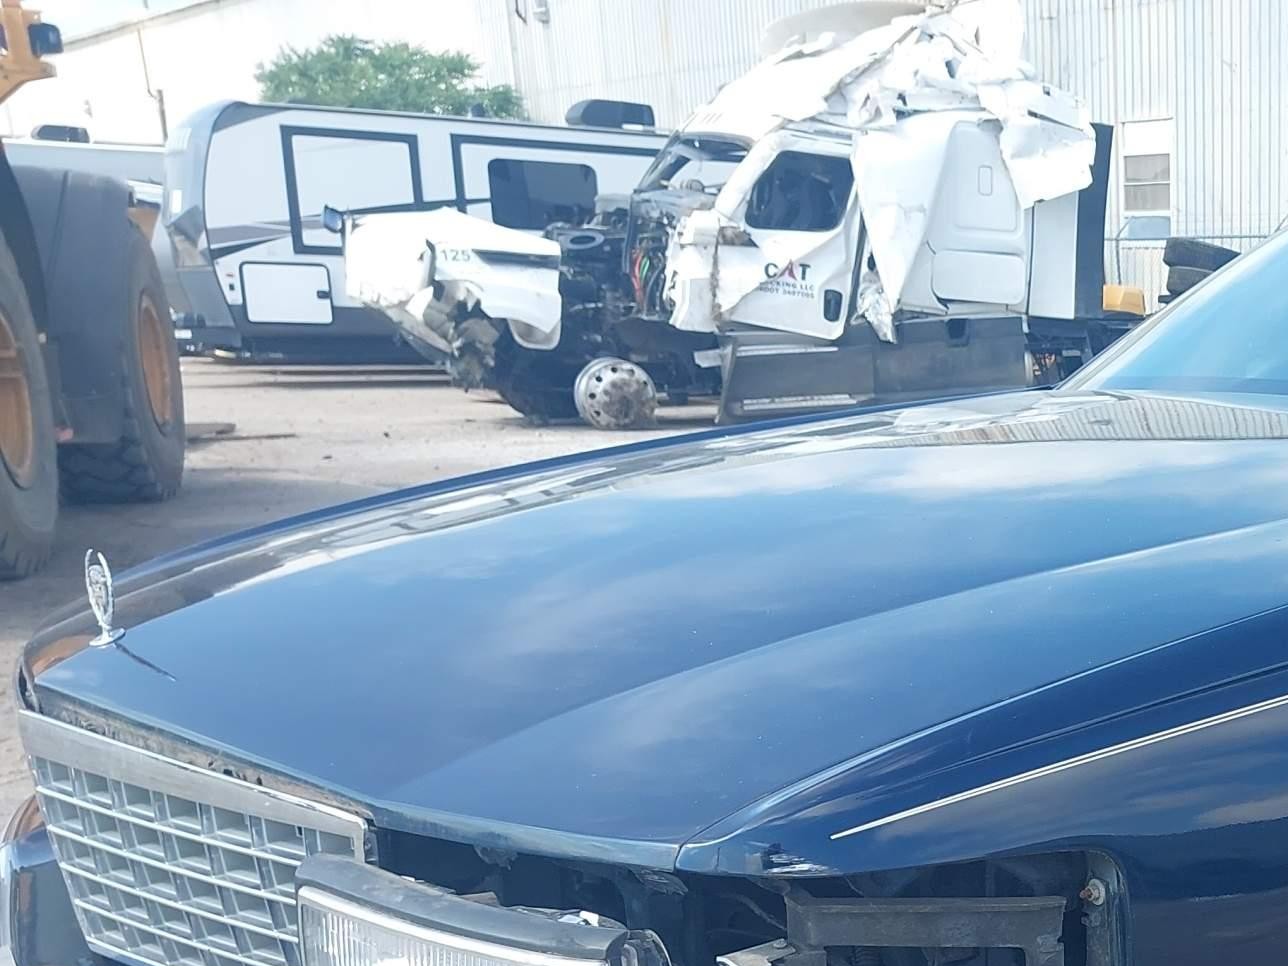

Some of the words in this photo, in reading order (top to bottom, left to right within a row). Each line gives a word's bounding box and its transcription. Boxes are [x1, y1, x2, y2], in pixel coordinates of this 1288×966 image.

[440, 249, 471, 262] 125
[764, 259, 811, 281] CAT
[800, 284, 815, 292] LLC
